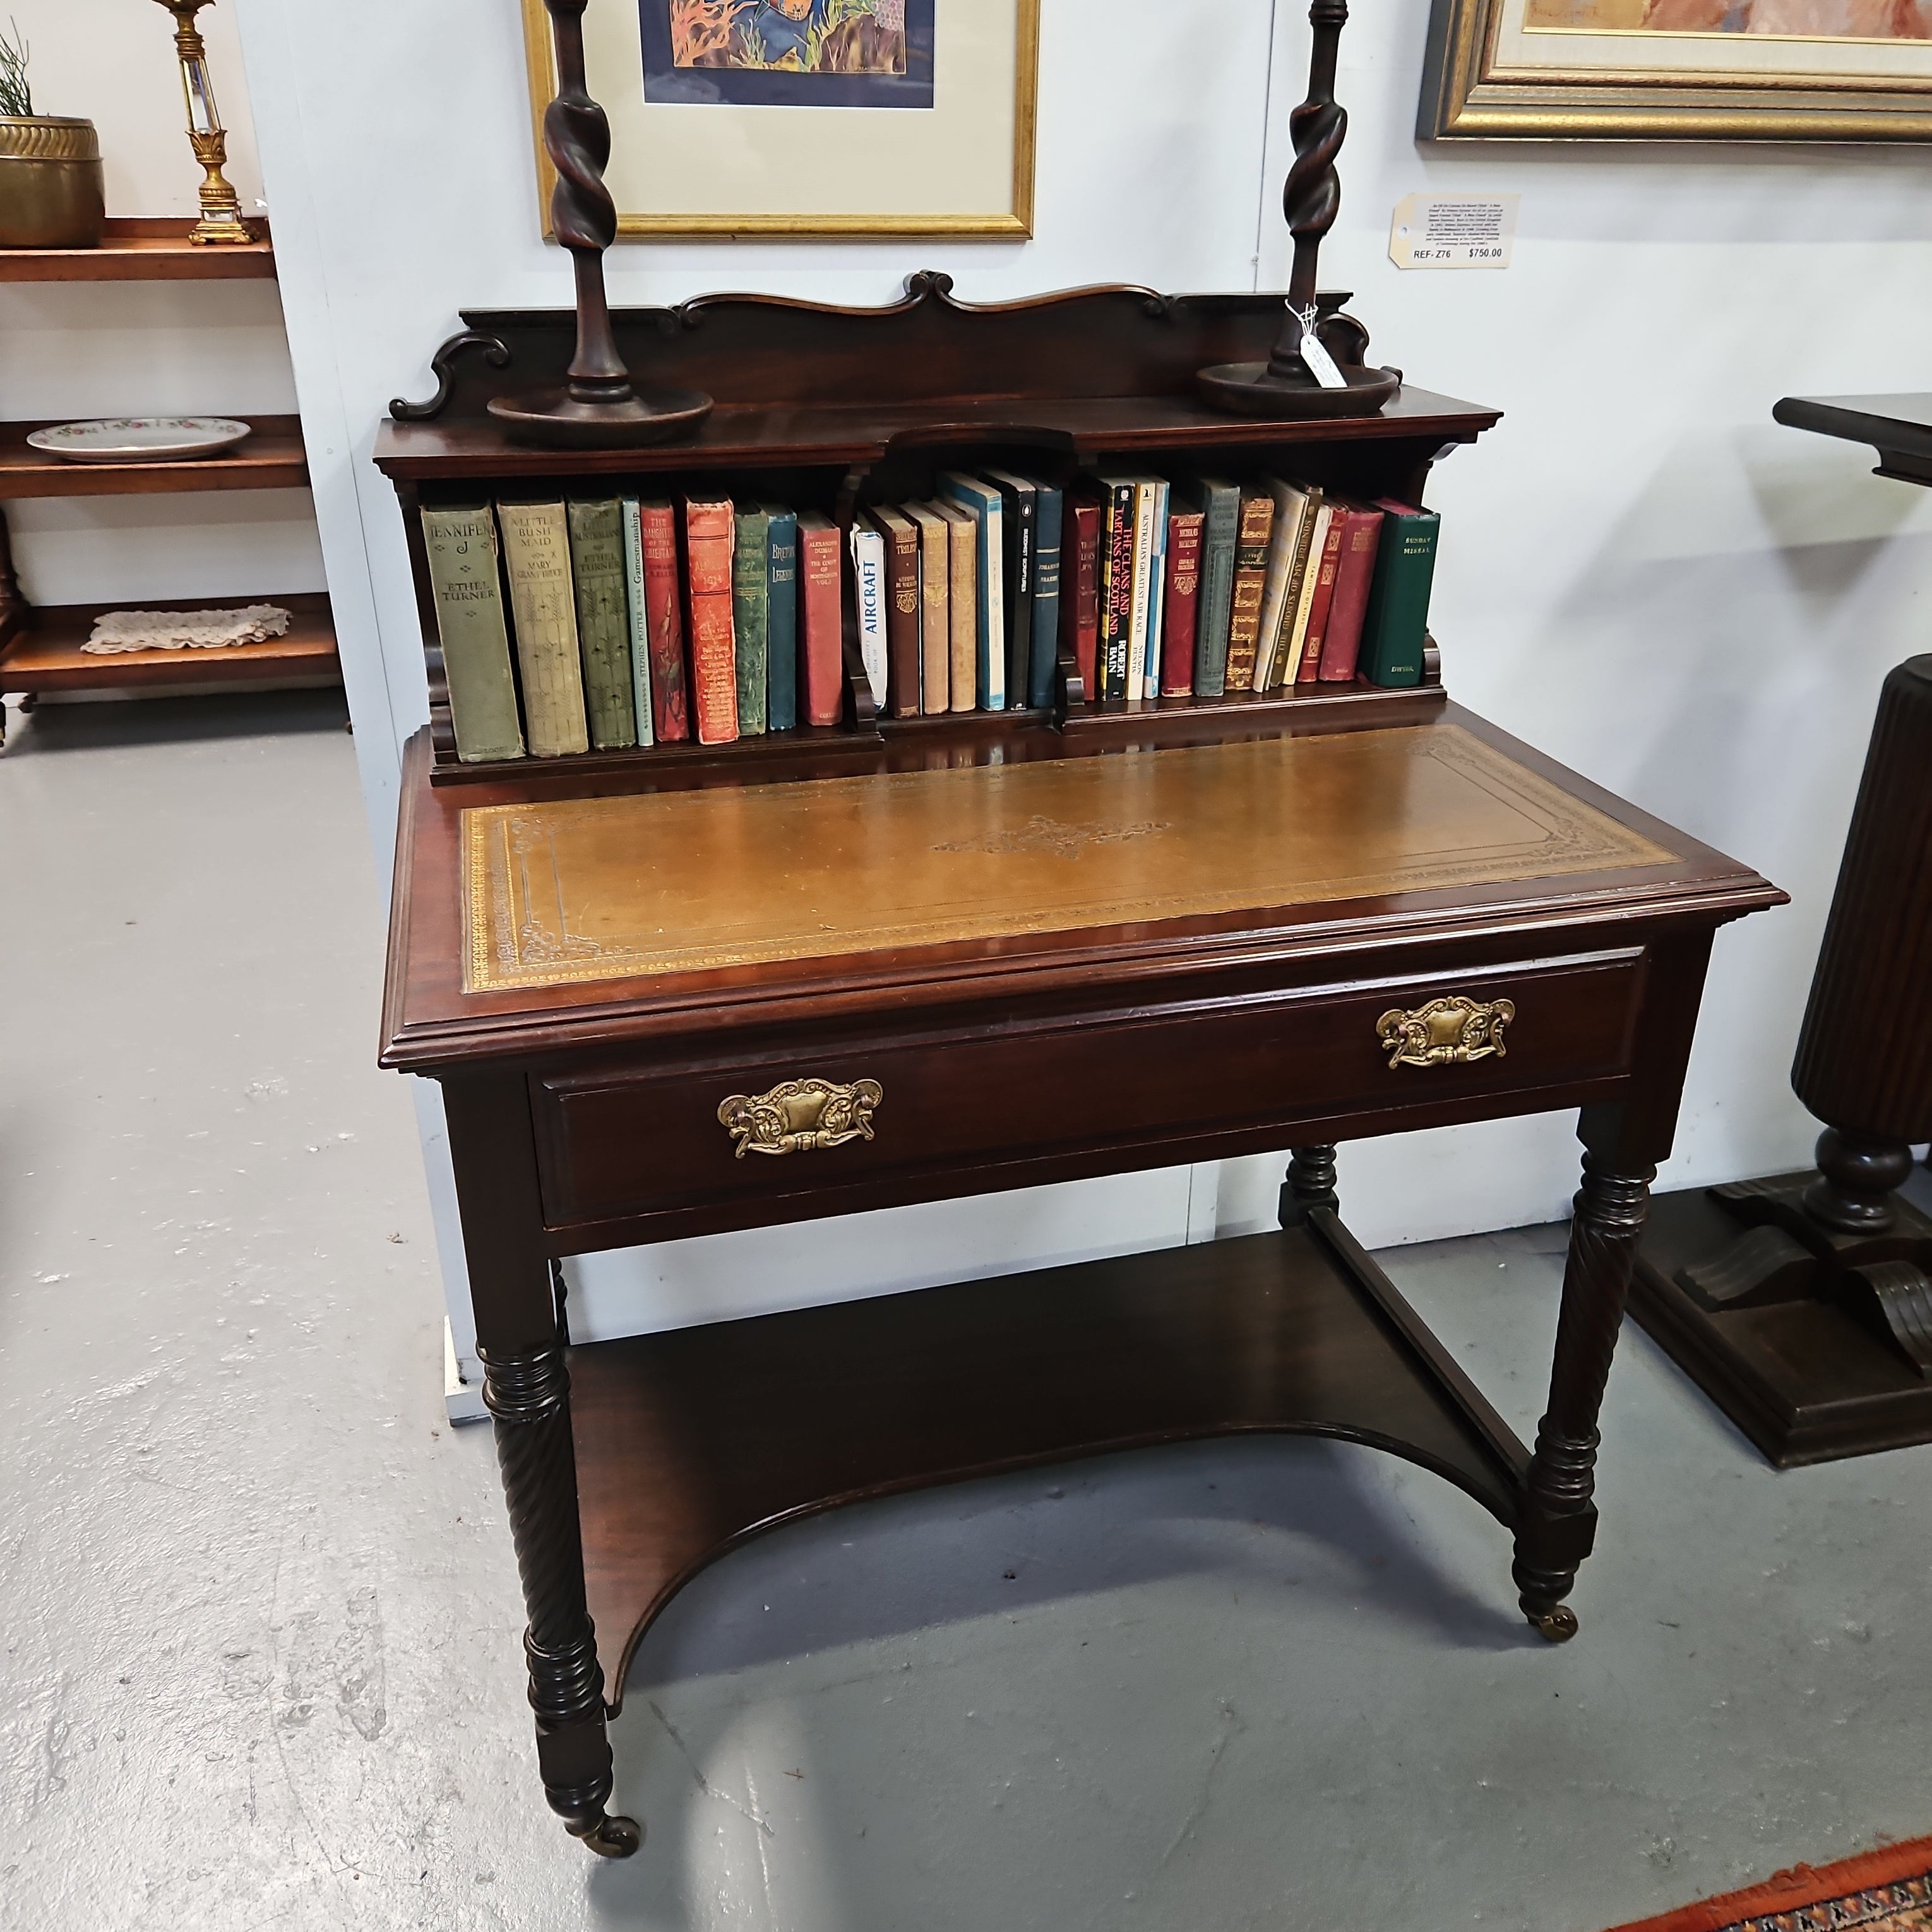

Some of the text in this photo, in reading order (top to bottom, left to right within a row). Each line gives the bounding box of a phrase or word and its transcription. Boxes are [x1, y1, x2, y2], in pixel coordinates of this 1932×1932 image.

[1469, 248, 1502, 258] $750.00
[519, 527, 551, 537] BUSH
[630, 512, 641, 584] Gamesmanship
[528, 561, 551, 570] MARY
[1109, 507, 1124, 636] TARTANS OF SCOTLAND
[1119, 527, 1133, 616] THE CLANS AND
[447, 581, 490, 592] ETHEL
[1277, 520, 1313, 653] THE GHOSTS OF MY FRIENDS
[1306, 566, 1316, 595] FAMILIES
[442, 590, 495, 601] TURNER
[862, 560, 878, 635] AIRCRAFT
[1109, 647, 1118, 673] BAIN
[1116, 640, 1126, 680] ROBERT
